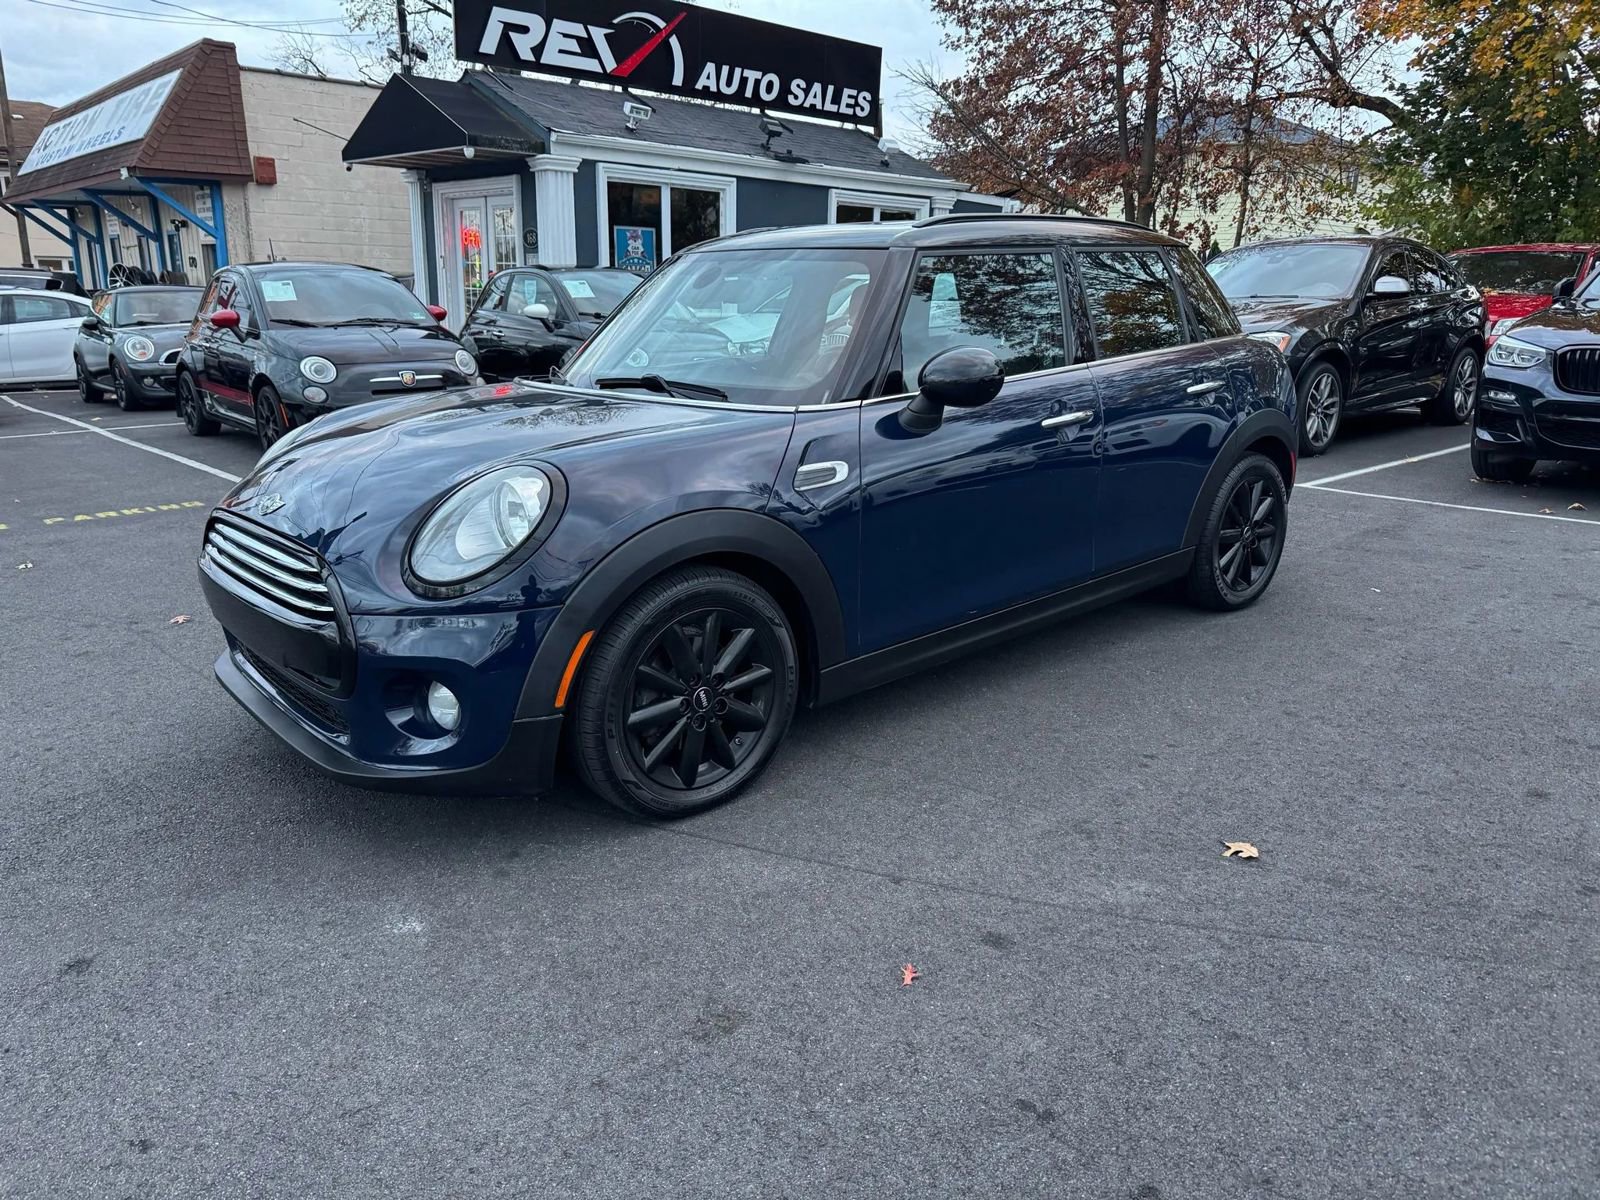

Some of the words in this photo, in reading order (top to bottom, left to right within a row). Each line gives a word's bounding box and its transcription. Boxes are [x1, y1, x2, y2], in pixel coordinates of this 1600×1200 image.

[694, 62, 781, 102] AUTO
[787, 78, 873, 118] SALES
[32, 106, 105, 154] ACTION
[105, 78, 174, 128] TIRE
[34, 144, 75, 167] CUSTOM
[75, 125, 126, 153] WHEELS
[43, 501, 206, 525] PARKING
